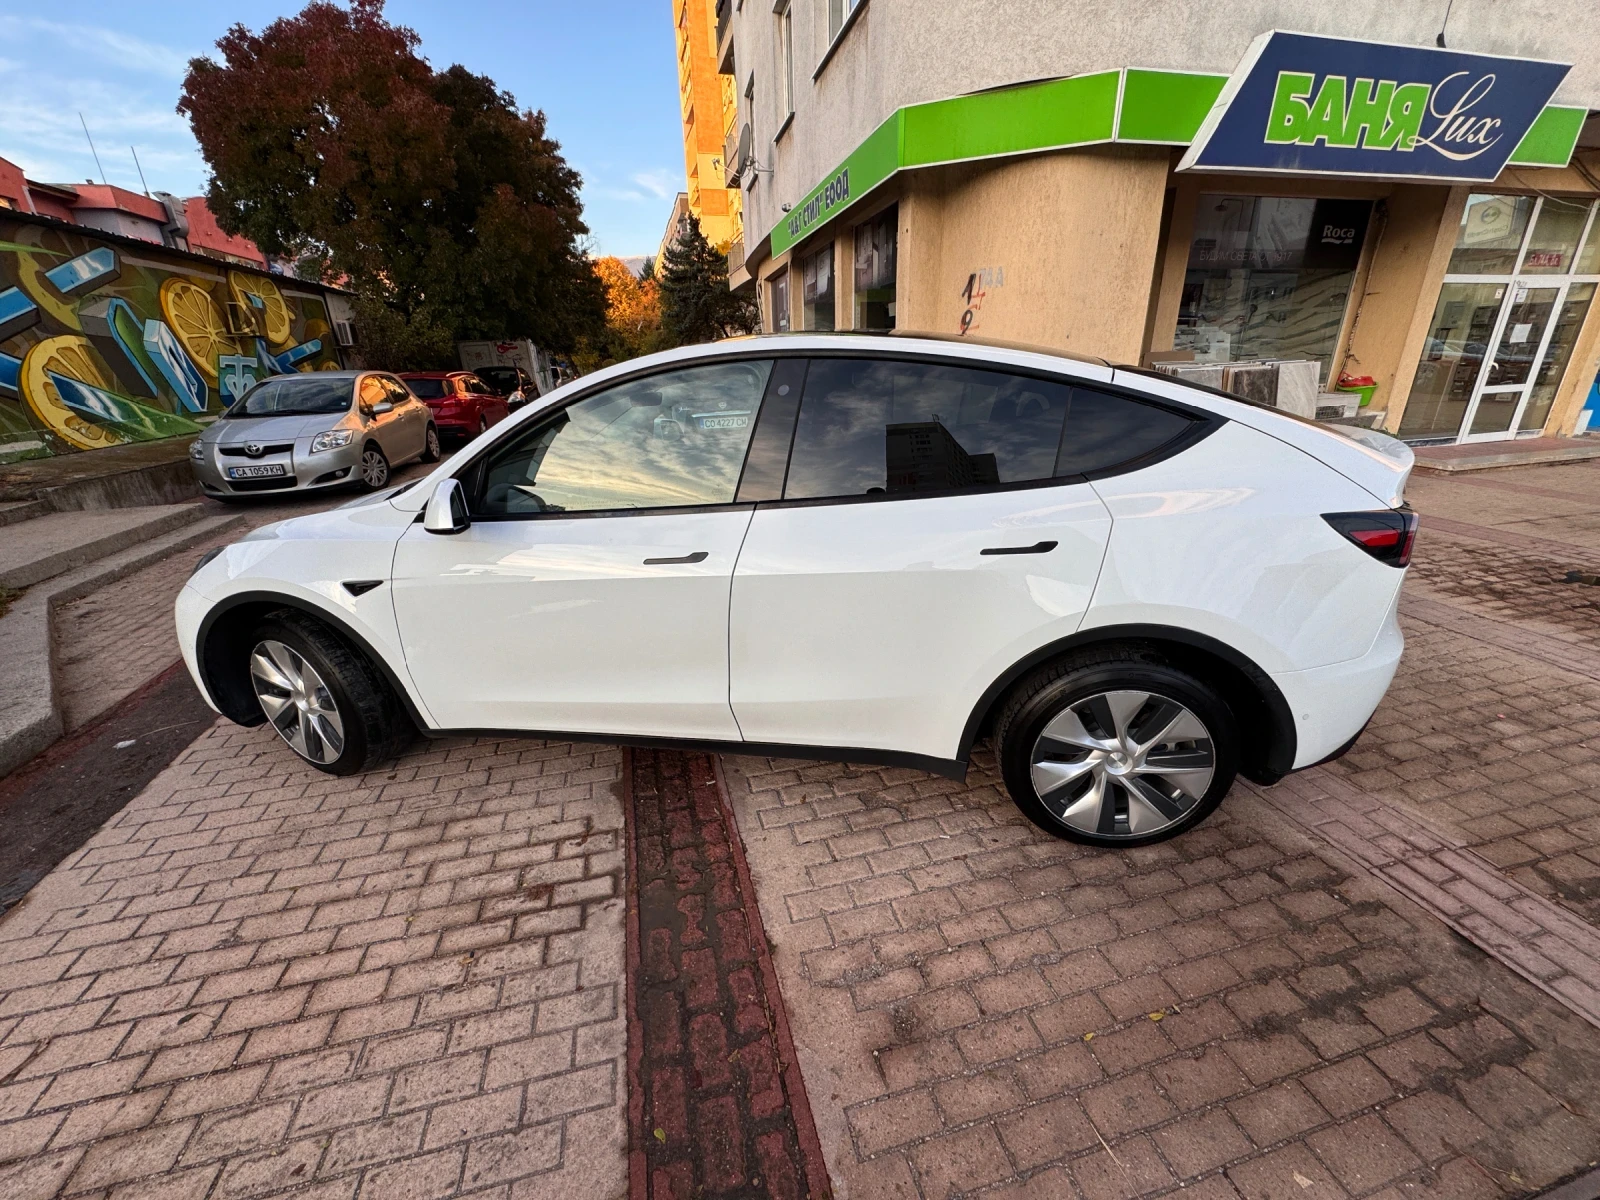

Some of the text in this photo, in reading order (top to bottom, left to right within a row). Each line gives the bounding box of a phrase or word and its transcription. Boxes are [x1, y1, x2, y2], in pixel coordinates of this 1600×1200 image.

[1263, 70, 1432, 152] БАНЯ
[1407, 71, 1504, 161] Lux
[824, 166, 849, 211] ЕООД
[1322, 224, 1356, 238] Roca
[716, 418, 735, 427] 4227
[235, 465, 282, 477] CA 1059 KH
